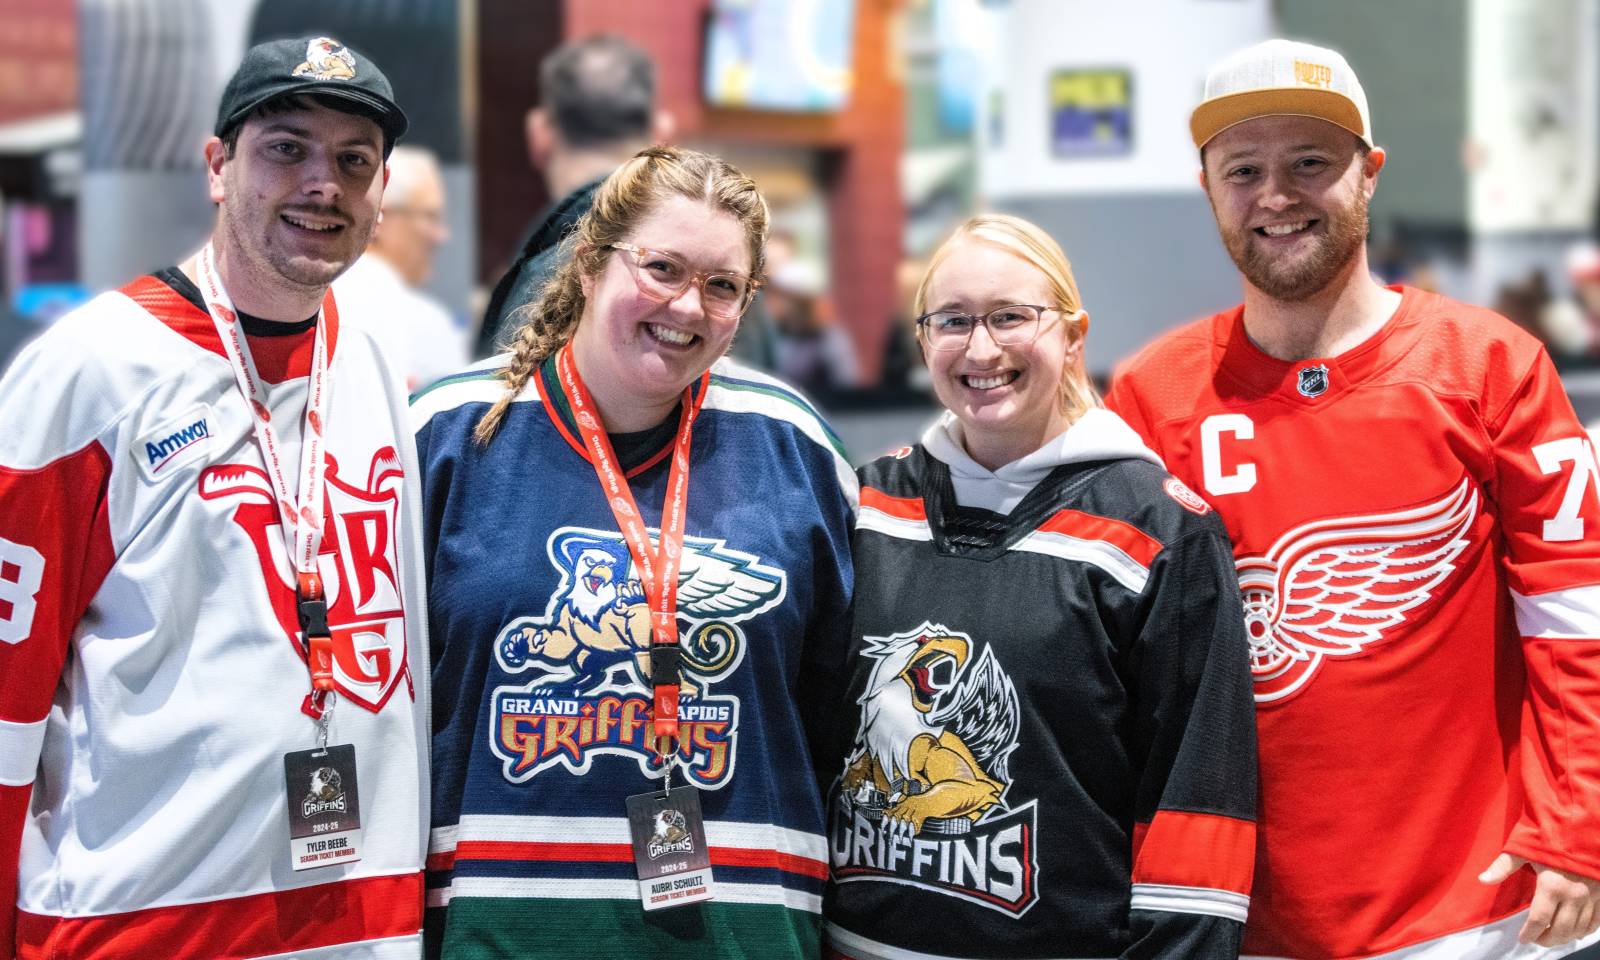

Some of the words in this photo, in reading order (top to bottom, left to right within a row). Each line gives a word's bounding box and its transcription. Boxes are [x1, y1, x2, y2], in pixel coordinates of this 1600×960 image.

[146, 418, 209, 465] Amway
[1201, 414, 1257, 496] C
[501, 699, 578, 715] GRAND
[677, 706, 729, 720] APIDS
[303, 796, 345, 816] GRIFFINS
[312, 821, 339, 833] 2024-25
[307, 842, 327, 853] TYLER
[328, 837, 347, 850] BEEBE
[649, 837, 692, 858] GRIFFINS
[300, 855, 319, 863] SEASON
[319, 851, 334, 860] TICKET
[661, 862, 687, 874] 2024-25
[651, 880, 673, 894] AUBRI
[674, 876, 703, 890] SCHULTZ
